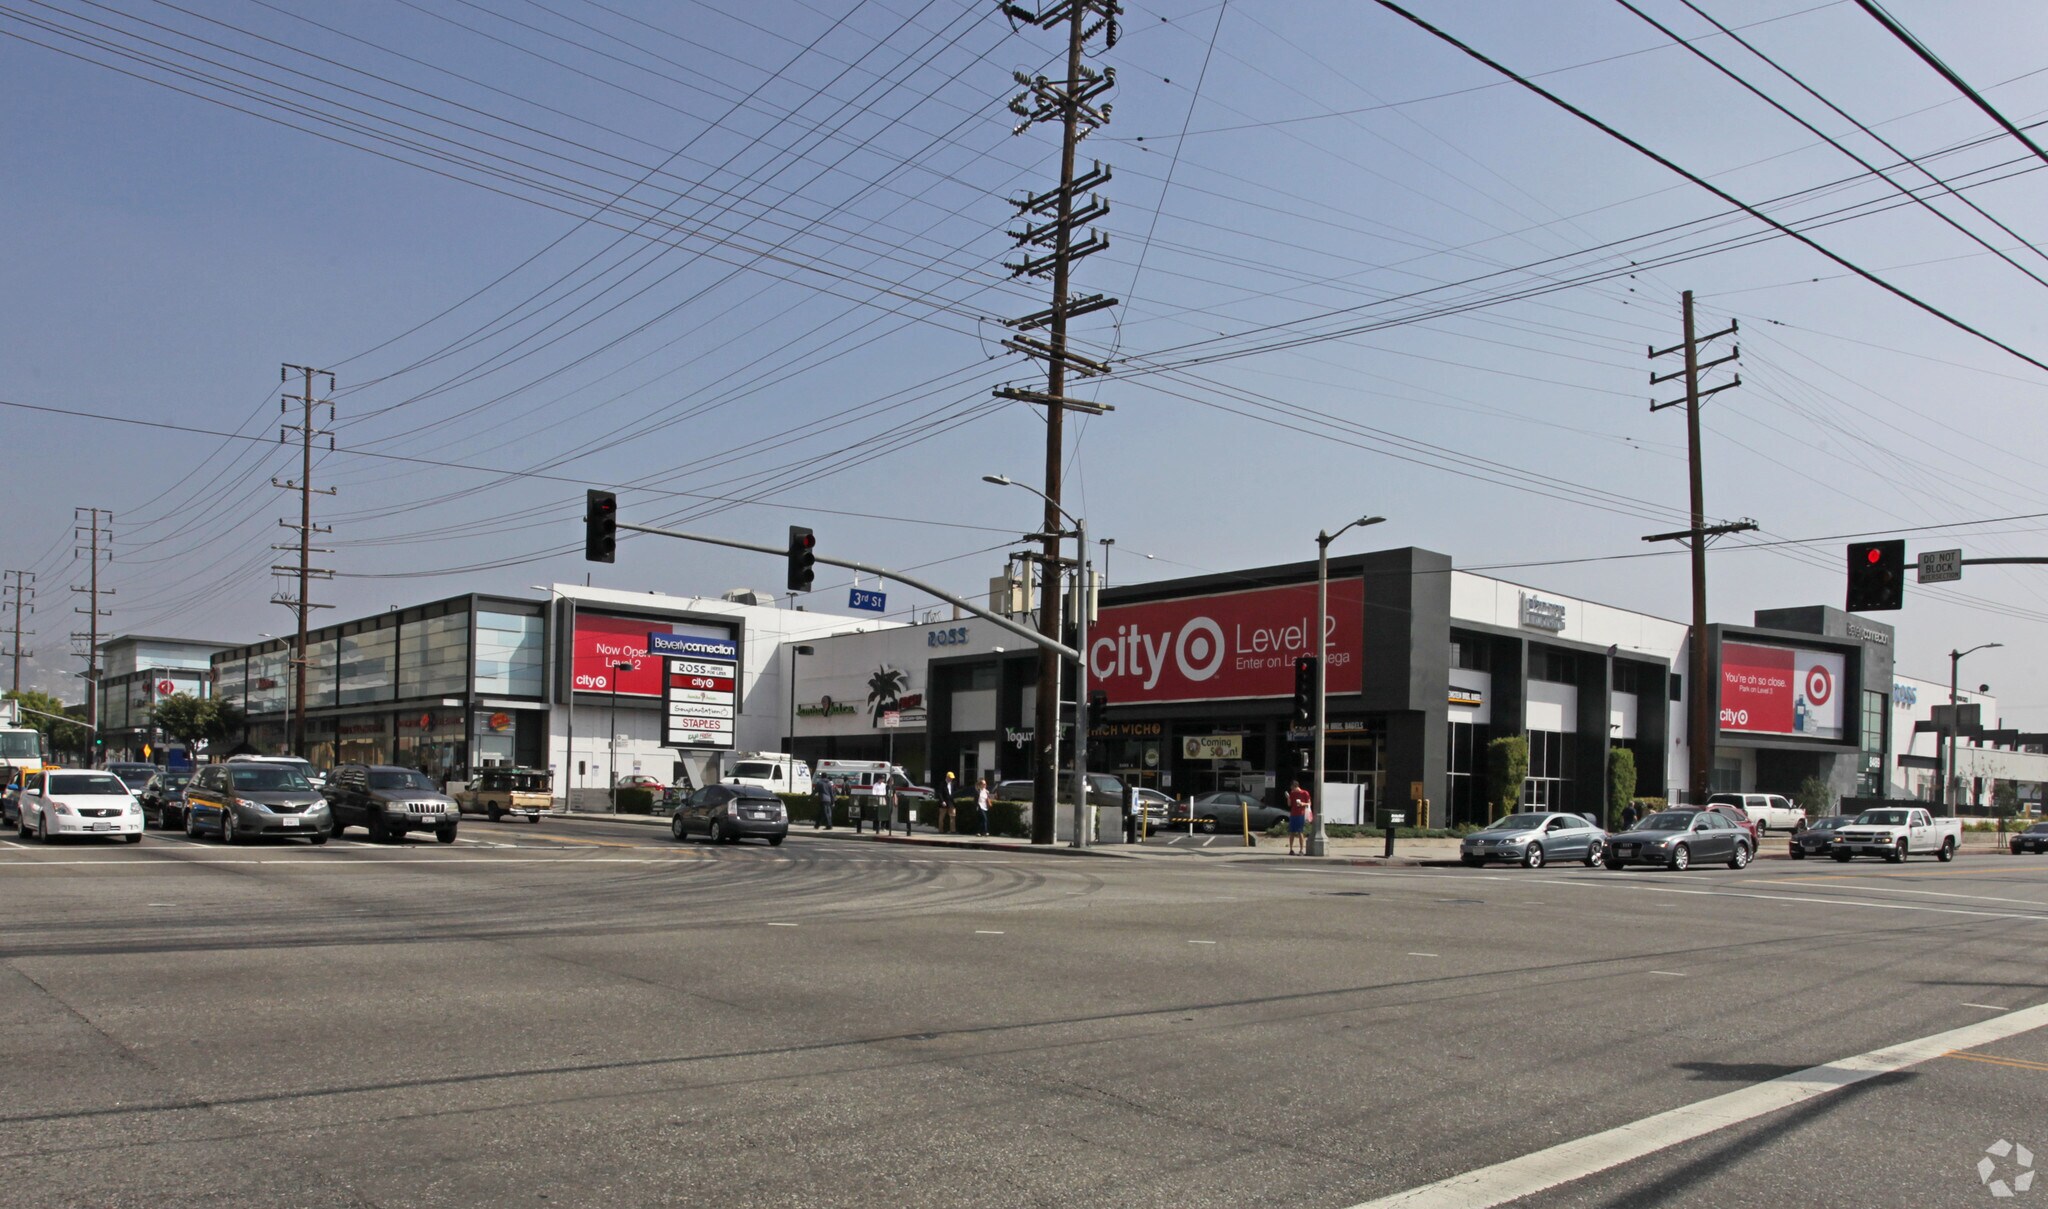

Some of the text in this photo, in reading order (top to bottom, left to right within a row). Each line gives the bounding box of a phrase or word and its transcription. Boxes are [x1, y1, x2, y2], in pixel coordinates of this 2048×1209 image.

[1923, 552, 1956, 564] DO NOT
[1925, 563, 1953, 574] BLOCK
[853, 592, 882, 608] 3rd St
[927, 627, 968, 648] ROSS
[1236, 617, 1307, 655] Level
[596, 643, 620, 656] Now
[1090, 624, 1172, 690] city
[634, 659, 642, 671] 2
[679, 663, 706, 674] ROSS
[1236, 657, 1263, 671] Enter
[1268, 657, 1282, 669] on
[576, 675, 595, 688] city
[691, 677, 706, 689] city
[1725, 672, 1746, 683] You're
[1747, 675, 1757, 684] oh
[1758, 678, 1767, 686] so
[1739, 685, 1750, 693] Park
[1719, 708, 1737, 726] city
[682, 718, 721, 730] STAPLES
[1121, 723, 1152, 736] WICH
[1201, 737, 1232, 749] Coming
